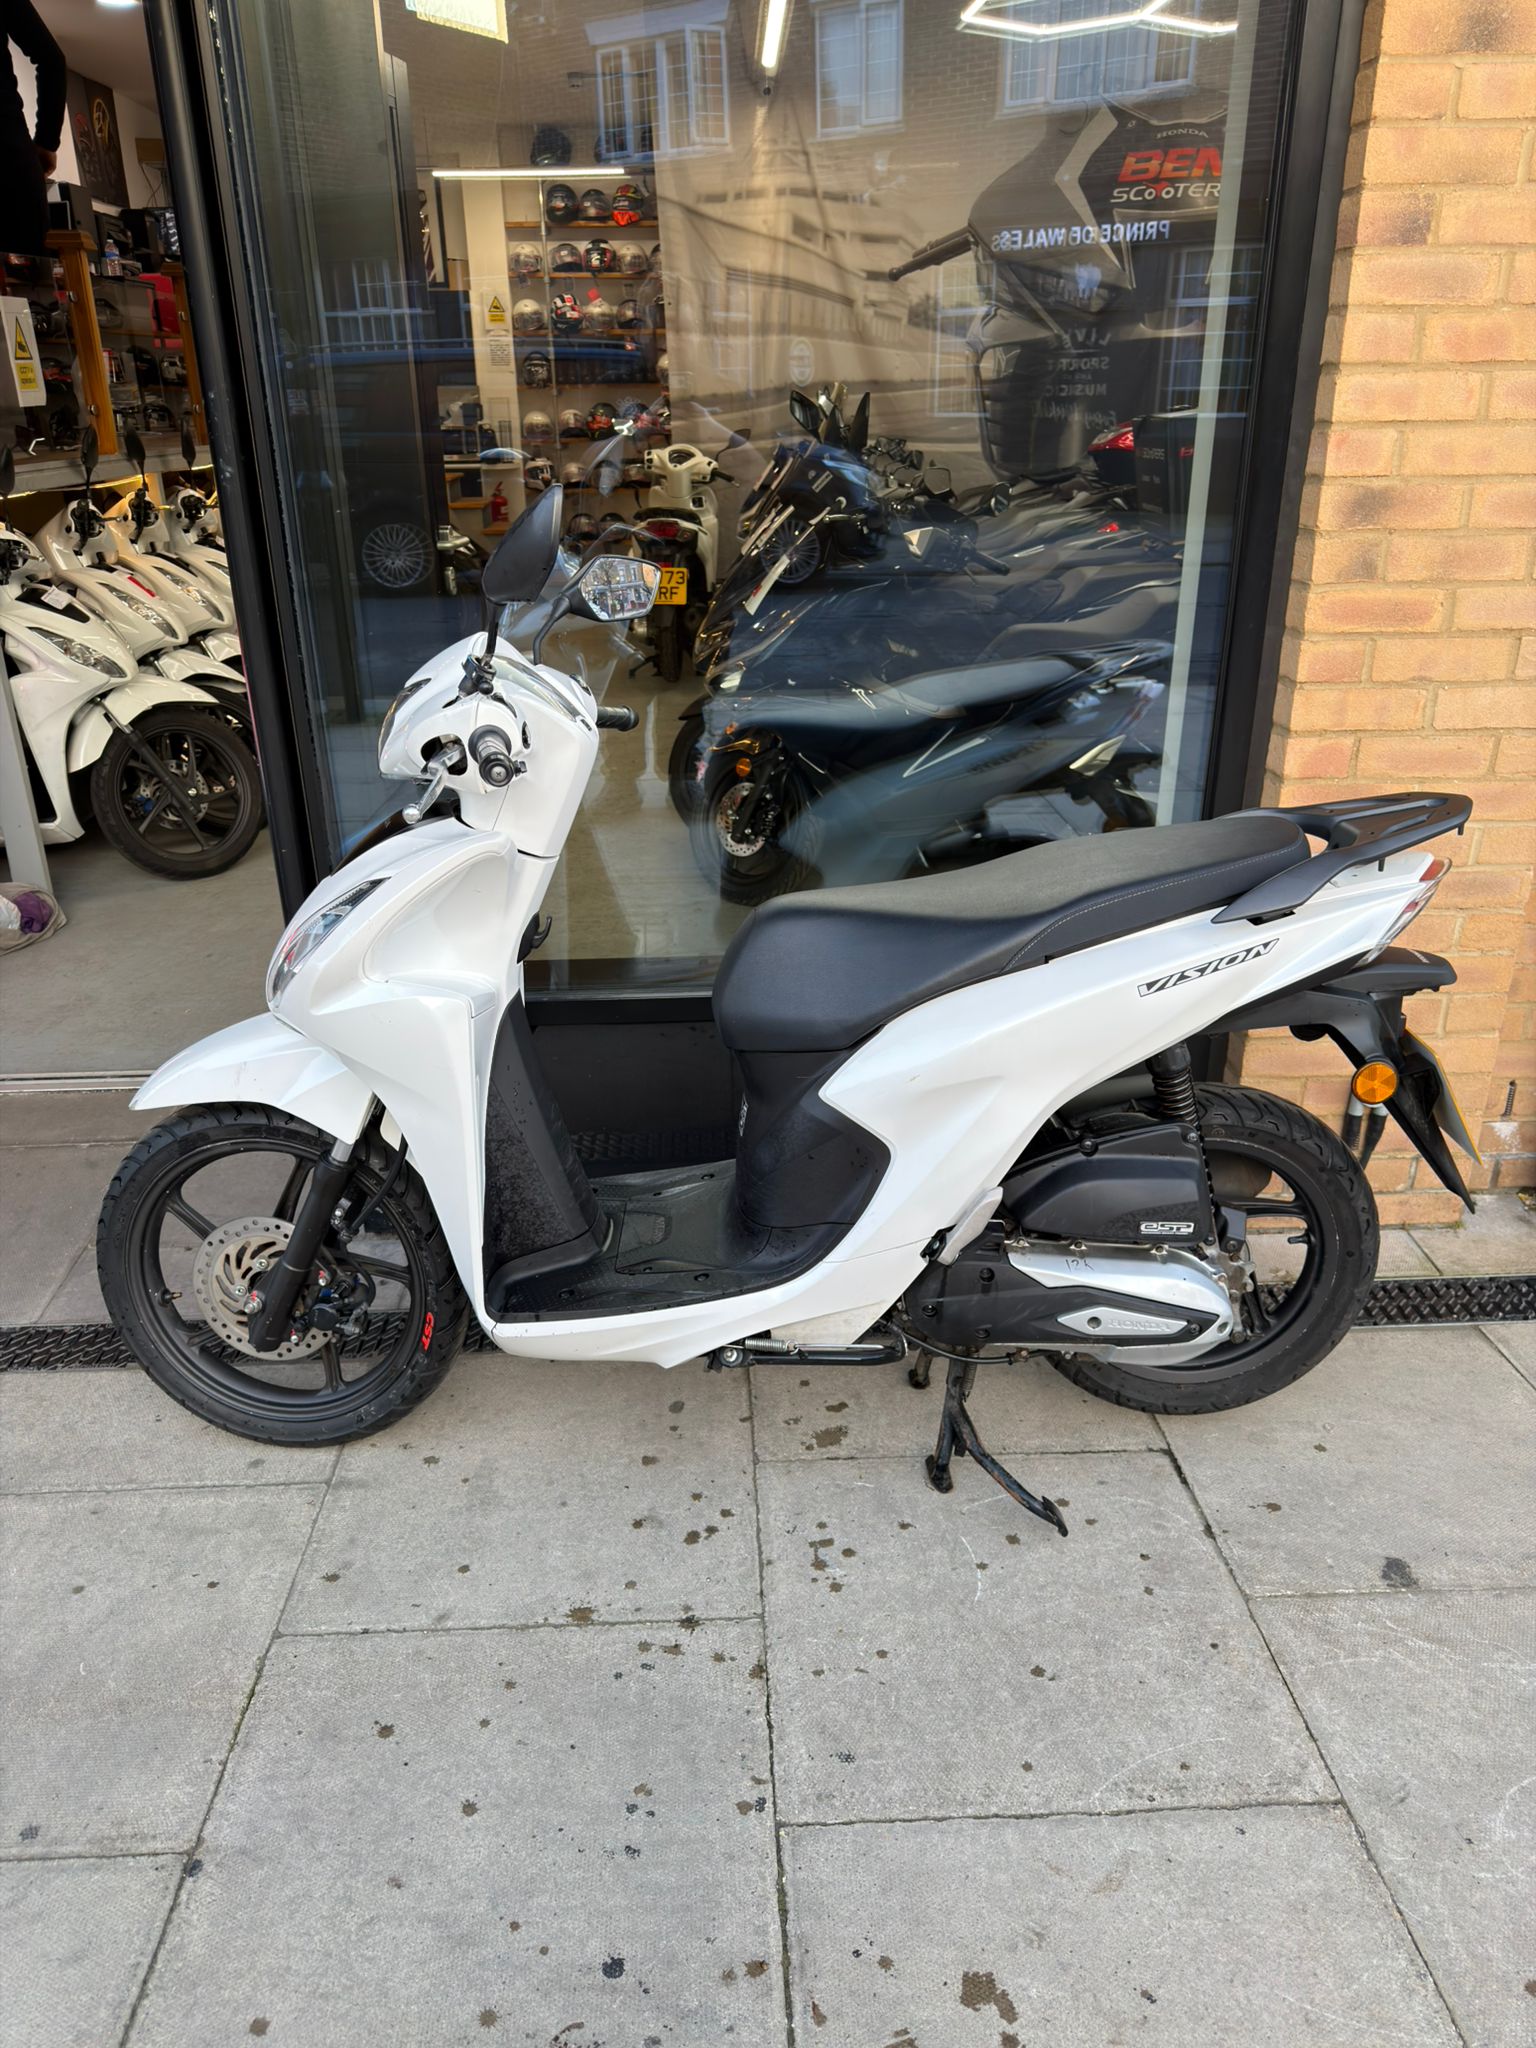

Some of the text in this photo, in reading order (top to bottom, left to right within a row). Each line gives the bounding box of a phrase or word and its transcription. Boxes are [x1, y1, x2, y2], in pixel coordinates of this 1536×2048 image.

[1156, 127, 1209, 139] HONDA
[661, 570, 686, 585] 73
[1137, 938, 1280, 997] VISION
[1107, 1318, 1172, 1333] HONDA
